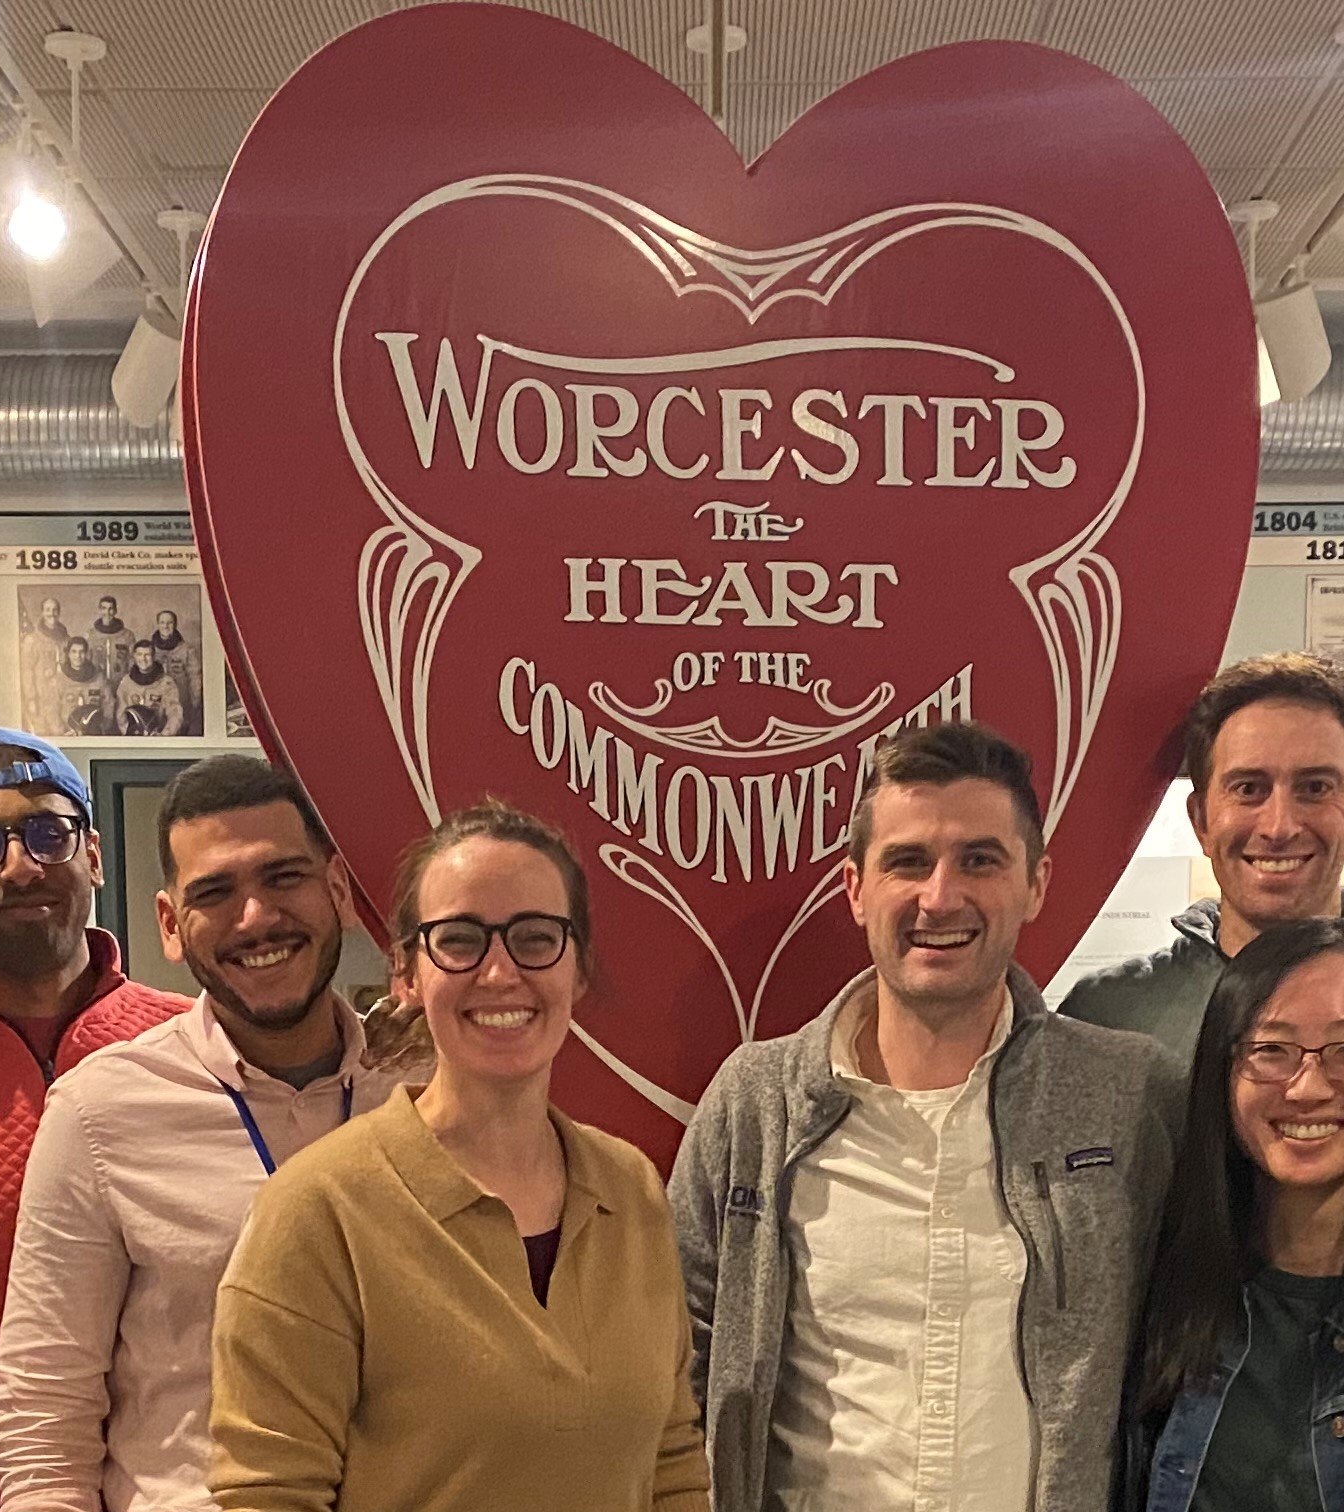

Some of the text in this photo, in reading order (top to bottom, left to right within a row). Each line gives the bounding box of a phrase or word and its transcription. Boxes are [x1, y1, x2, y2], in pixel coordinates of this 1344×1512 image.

[374, 333, 1077, 491] WORCESTER
[76, 521, 139, 541] 1989
[693, 501, 803, 542] THE
[1254, 511, 1317, 532] 1804
[16, 550, 77, 570] 1988
[83, 551, 109, 559] David
[111, 551, 135, 559] Clark
[154, 551, 183, 559] makes
[563, 557, 898, 628] HEART
[672, 651, 815, 694] OF THE
